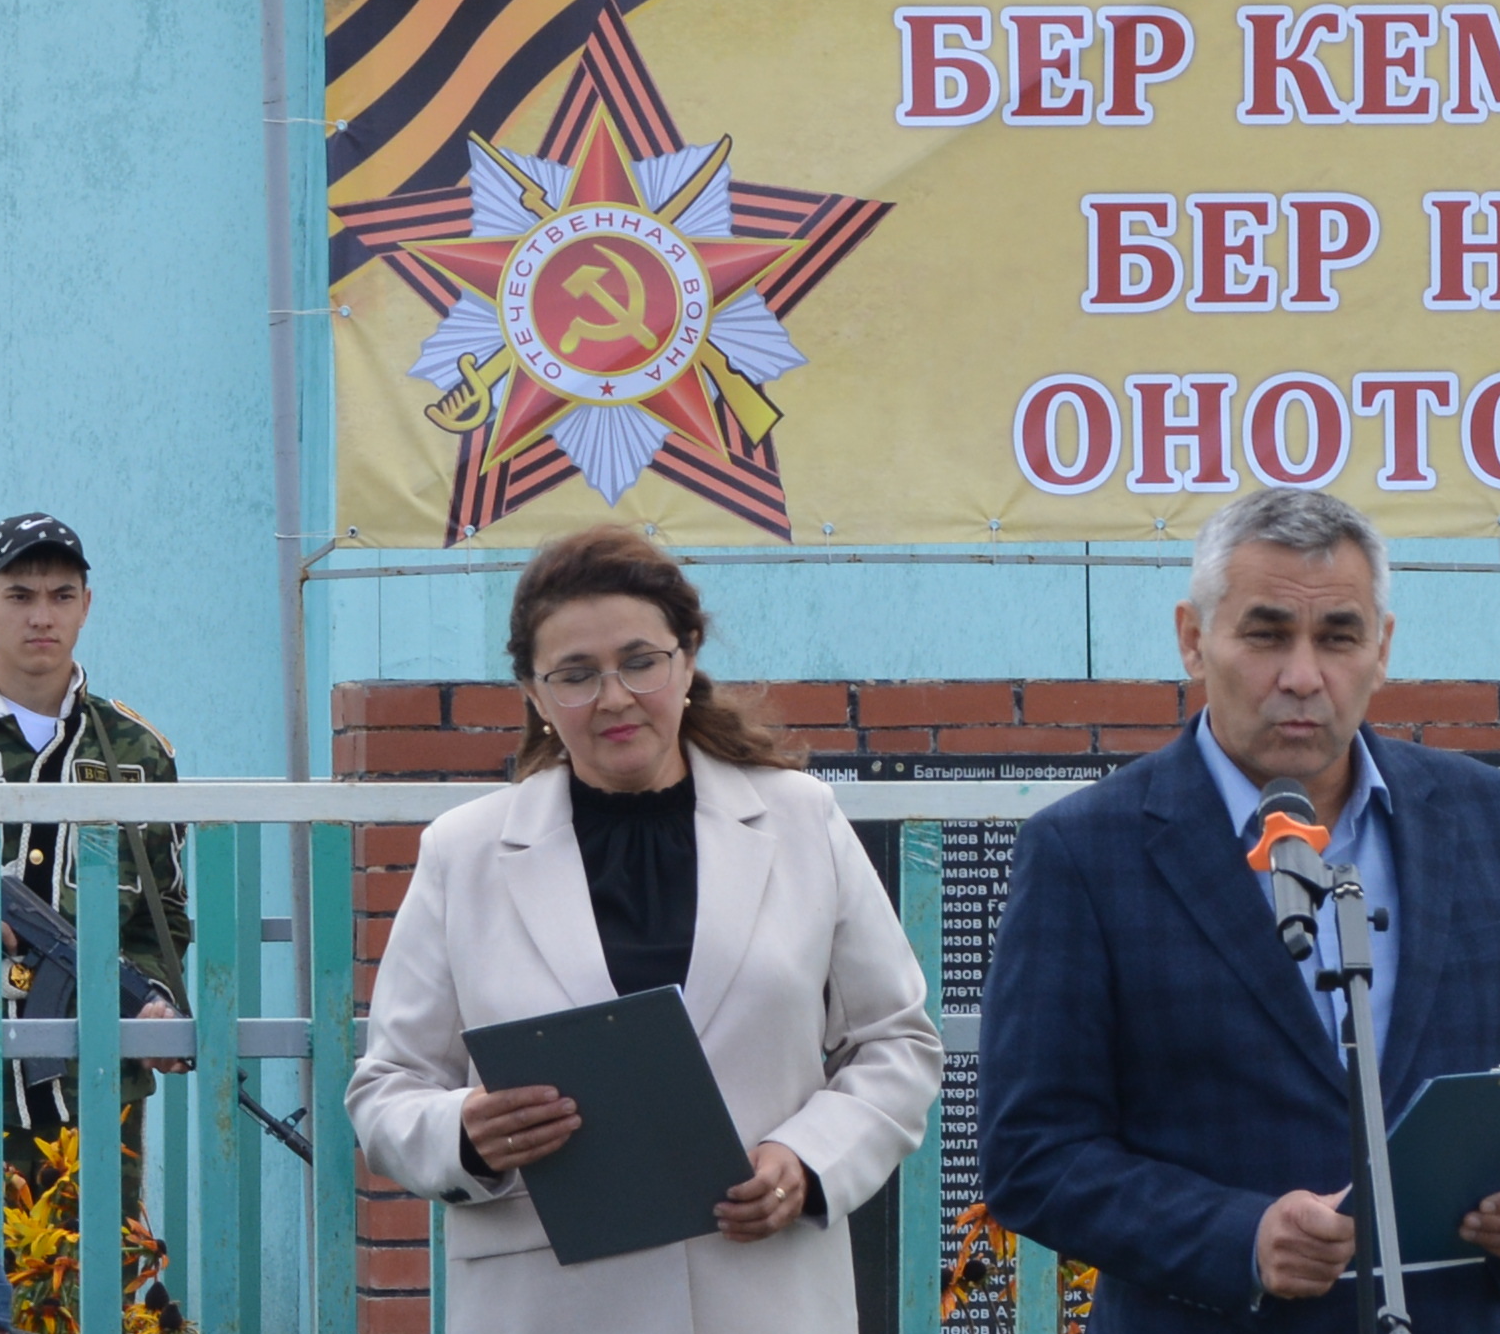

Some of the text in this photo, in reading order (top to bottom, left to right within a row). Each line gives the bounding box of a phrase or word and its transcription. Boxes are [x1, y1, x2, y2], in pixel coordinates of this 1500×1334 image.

[897, 5, 1194, 127] БЕР
[508, 212, 703, 382] ОТЕЧЕСТВЕННАЯ ВОЙНА
[1080, 191, 1379, 313] БЕР
[913, 764, 995, 780] Батыршин
